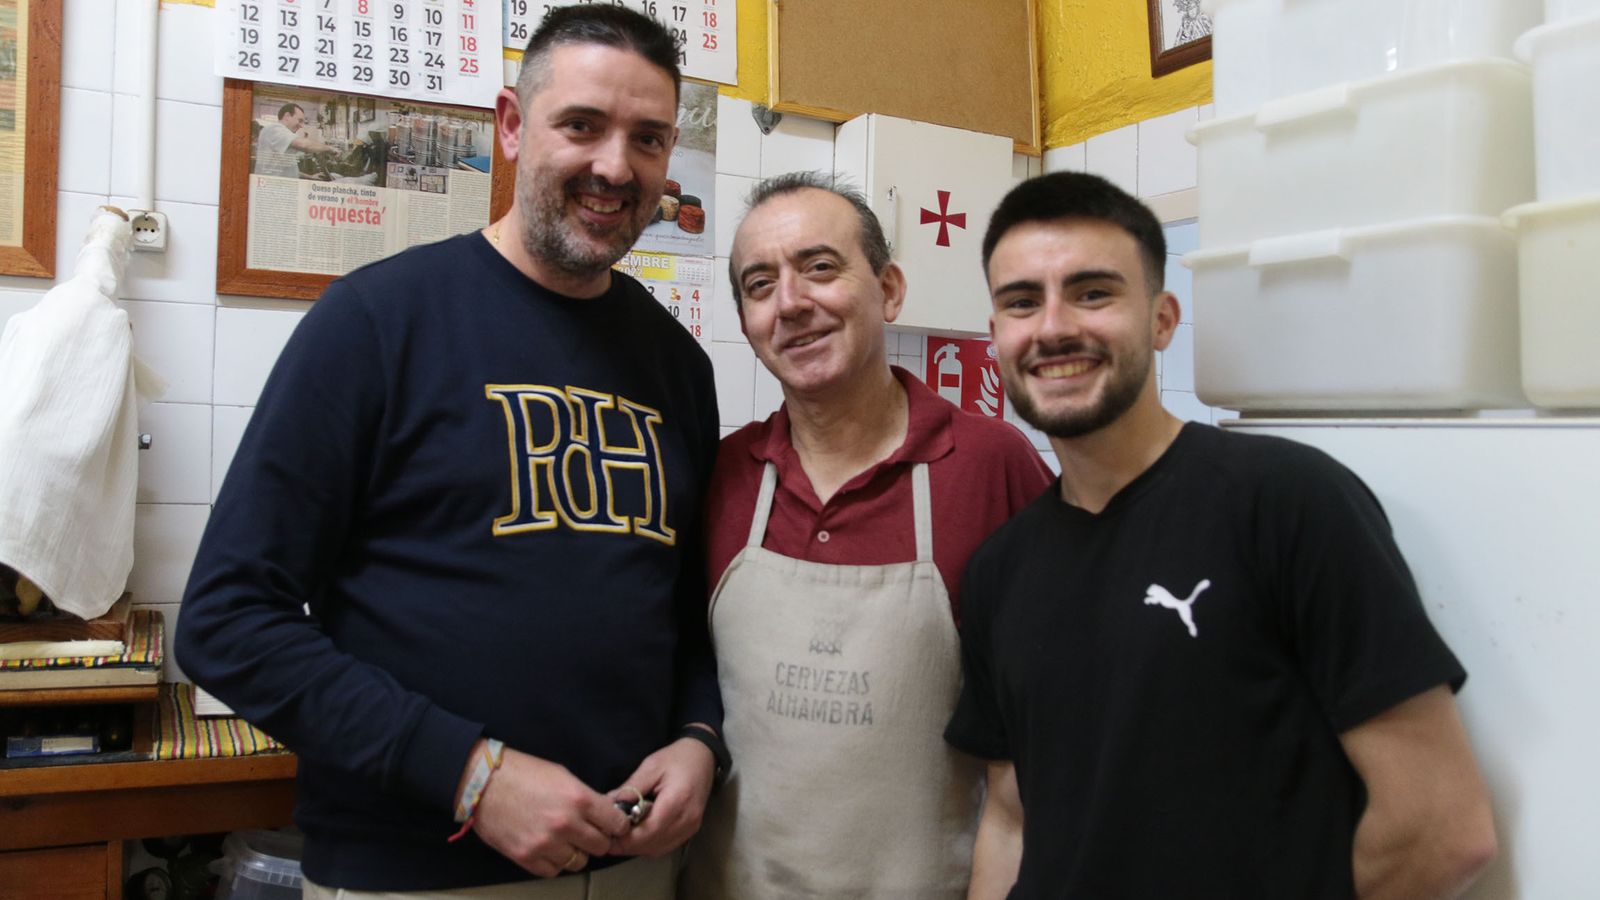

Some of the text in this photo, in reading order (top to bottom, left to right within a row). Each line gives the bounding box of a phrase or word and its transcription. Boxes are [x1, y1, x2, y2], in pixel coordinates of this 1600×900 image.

[241, 4, 477, 52] 12 13 14 15 16 17 18
[358, 0, 474, 30] 8 9 10 11
[511, 0, 527, 16] 19
[703, 33, 717, 50] 25
[642, 0, 657, 17] 16
[672, 6, 687, 22] 17
[703, 11, 717, 28] 18
[510, 22, 528, 39] 26
[241, 28, 479, 73] 19 20 21 22 23 24 25
[238, 51, 442, 91] 26 27 28 29 30 31
[312, 184, 376, 197] Queso plancha, tinto
[317, 195, 339, 203] verano
[341, 197, 345, 205] y
[347, 196, 353, 204] el
[616, 254, 670, 269] EMBRE
[671, 288, 678, 300] 3
[692, 290, 700, 302] 4
[690, 307, 701, 320] 11
[690, 324, 701, 337] 18
[775, 662, 870, 696] CERVEZAS
[766, 690, 873, 726] ALHAMBRA
